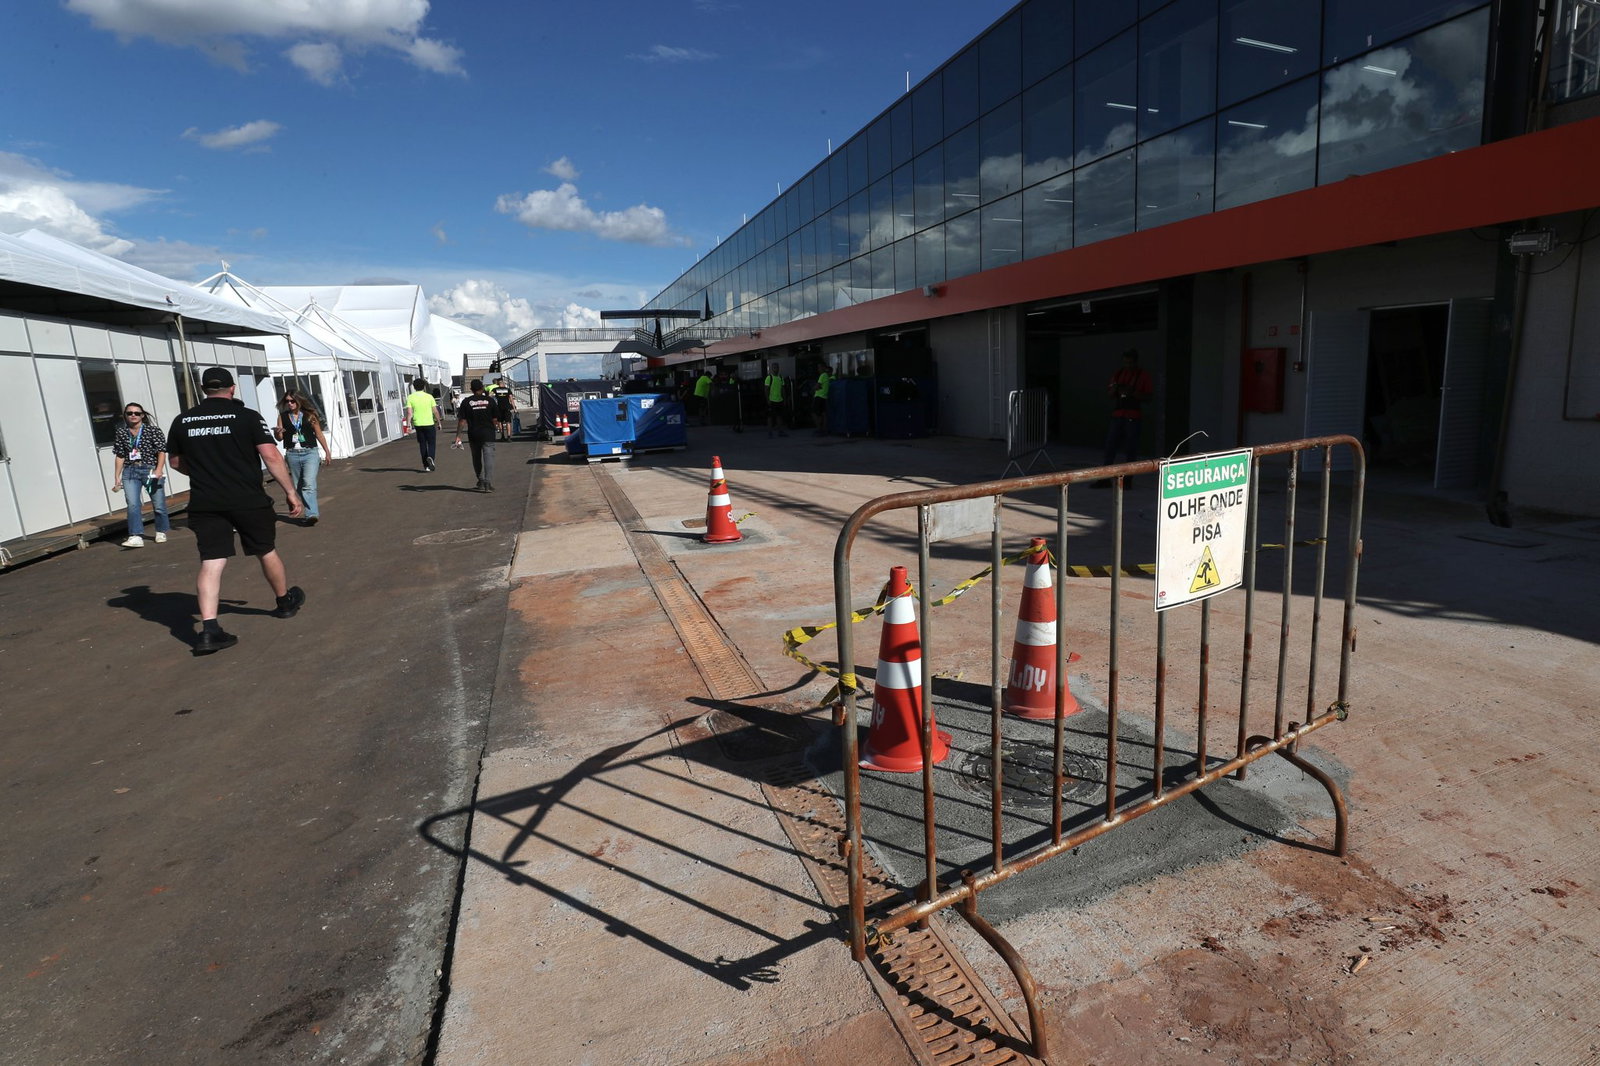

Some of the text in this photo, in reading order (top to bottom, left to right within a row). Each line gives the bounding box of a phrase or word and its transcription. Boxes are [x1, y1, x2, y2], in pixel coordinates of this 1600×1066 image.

[1167, 463, 1245, 491] SEGURANÇA
[1168, 489, 1243, 519] OLHE ONDE
[1193, 522, 1222, 544] PISA
